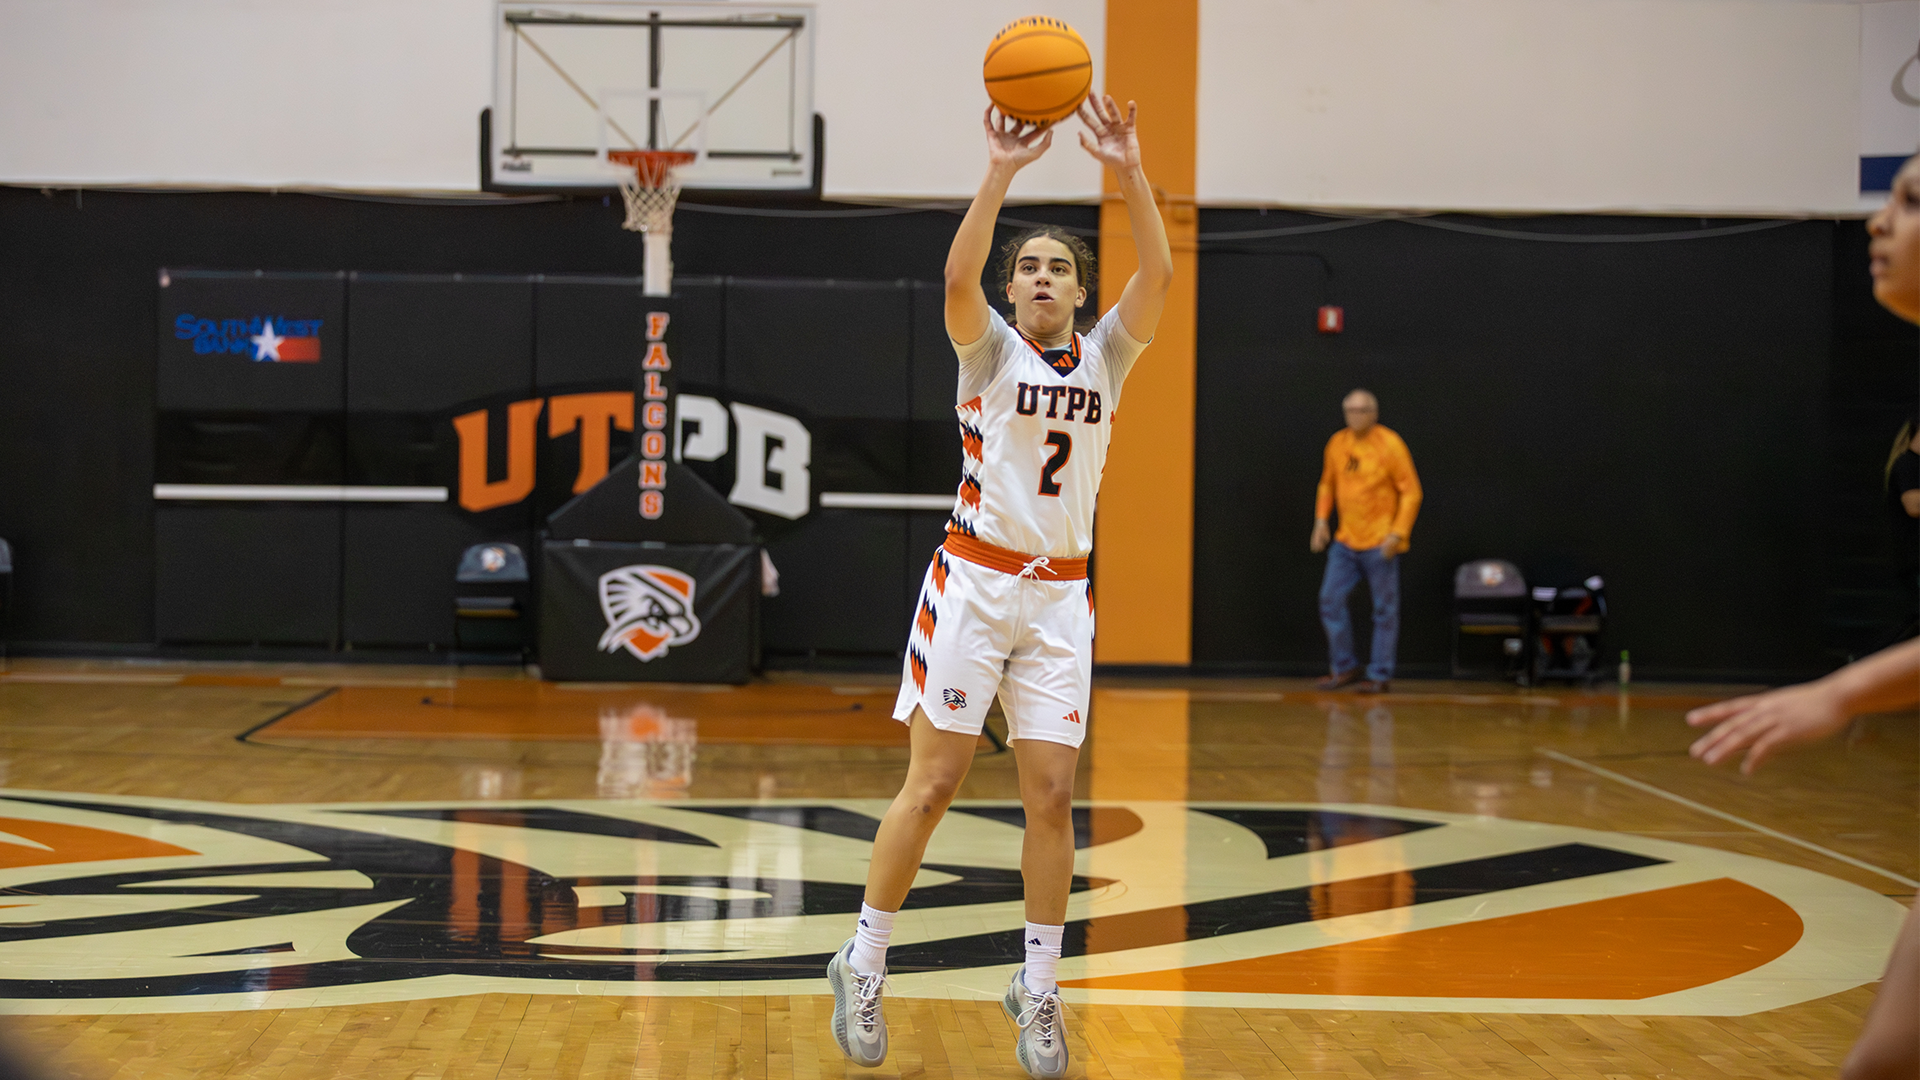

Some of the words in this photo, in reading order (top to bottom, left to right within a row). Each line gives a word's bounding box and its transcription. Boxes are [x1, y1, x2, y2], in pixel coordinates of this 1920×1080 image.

[639, 312, 671, 520] FALCONS
[1016, 382, 1101, 425] UTPB
[452, 391, 811, 520] UTPB
[1038, 429, 1072, 497] 2
